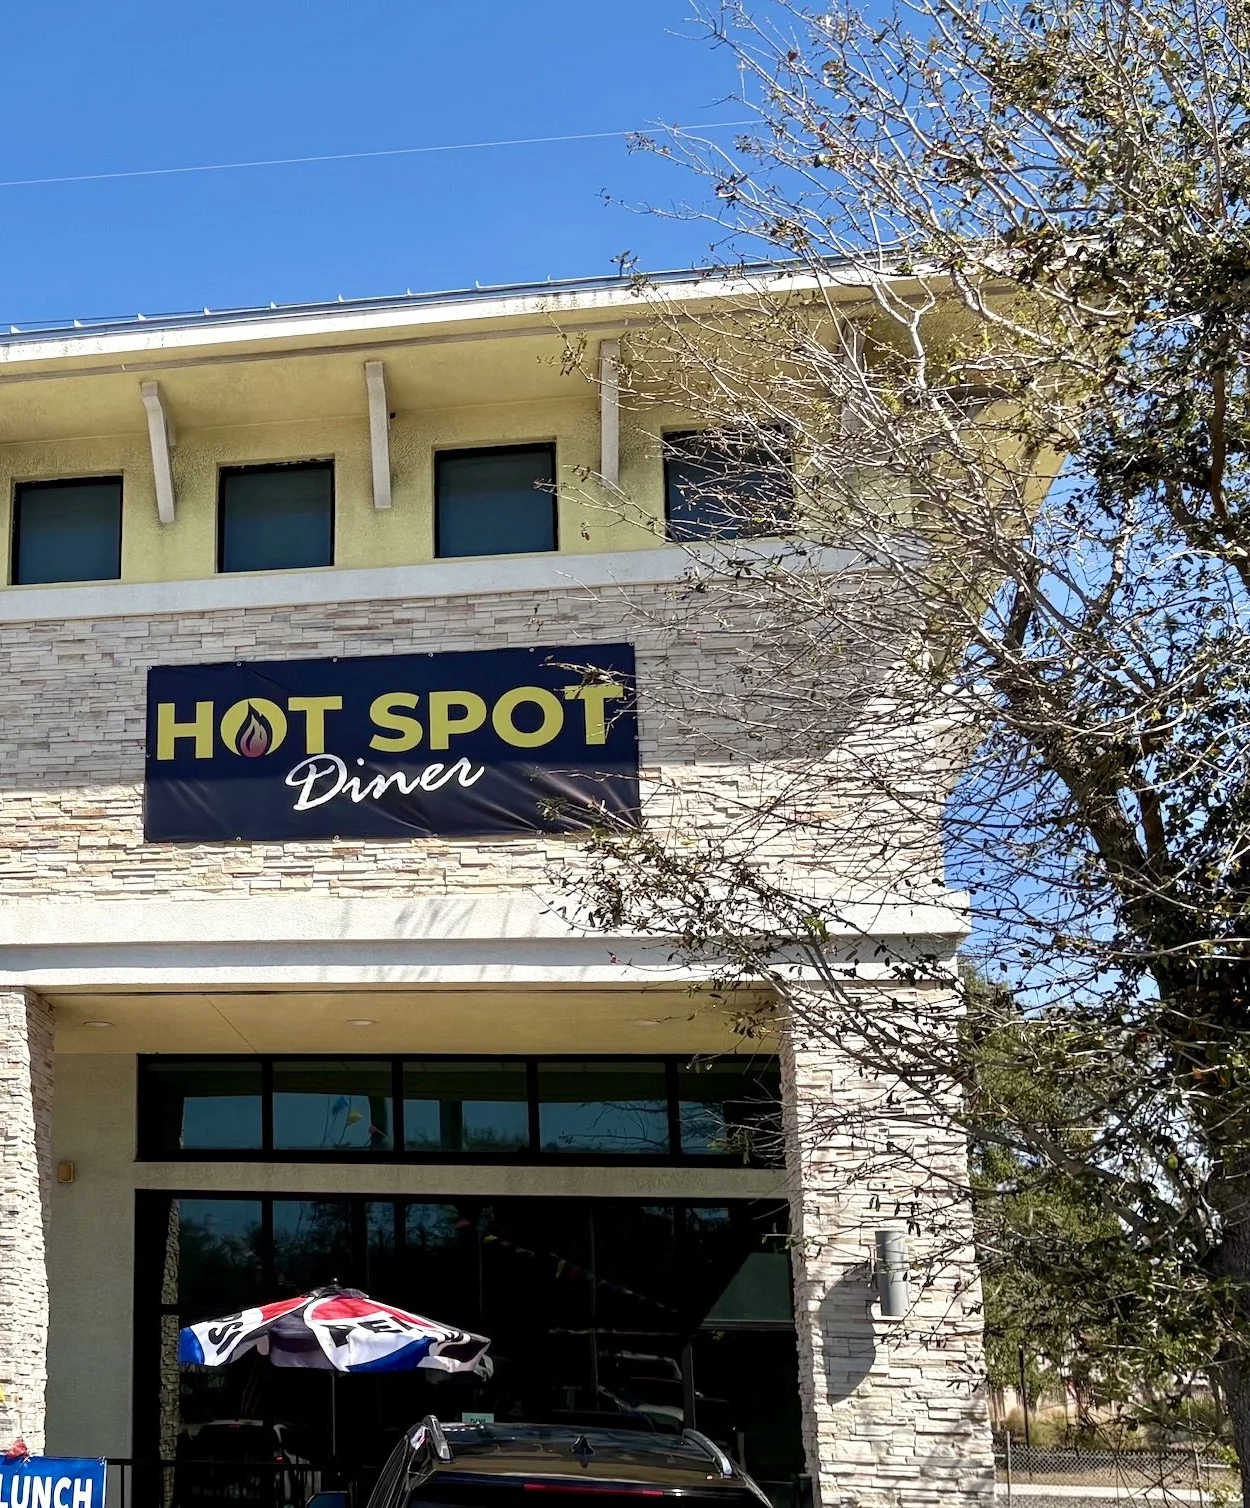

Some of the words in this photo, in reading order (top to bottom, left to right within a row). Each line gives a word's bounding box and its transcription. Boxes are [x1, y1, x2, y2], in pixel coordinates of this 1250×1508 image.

[156, 695, 343, 761] HOT
[368, 685, 625, 753] SPOT
[284, 752, 486, 812] Diner
